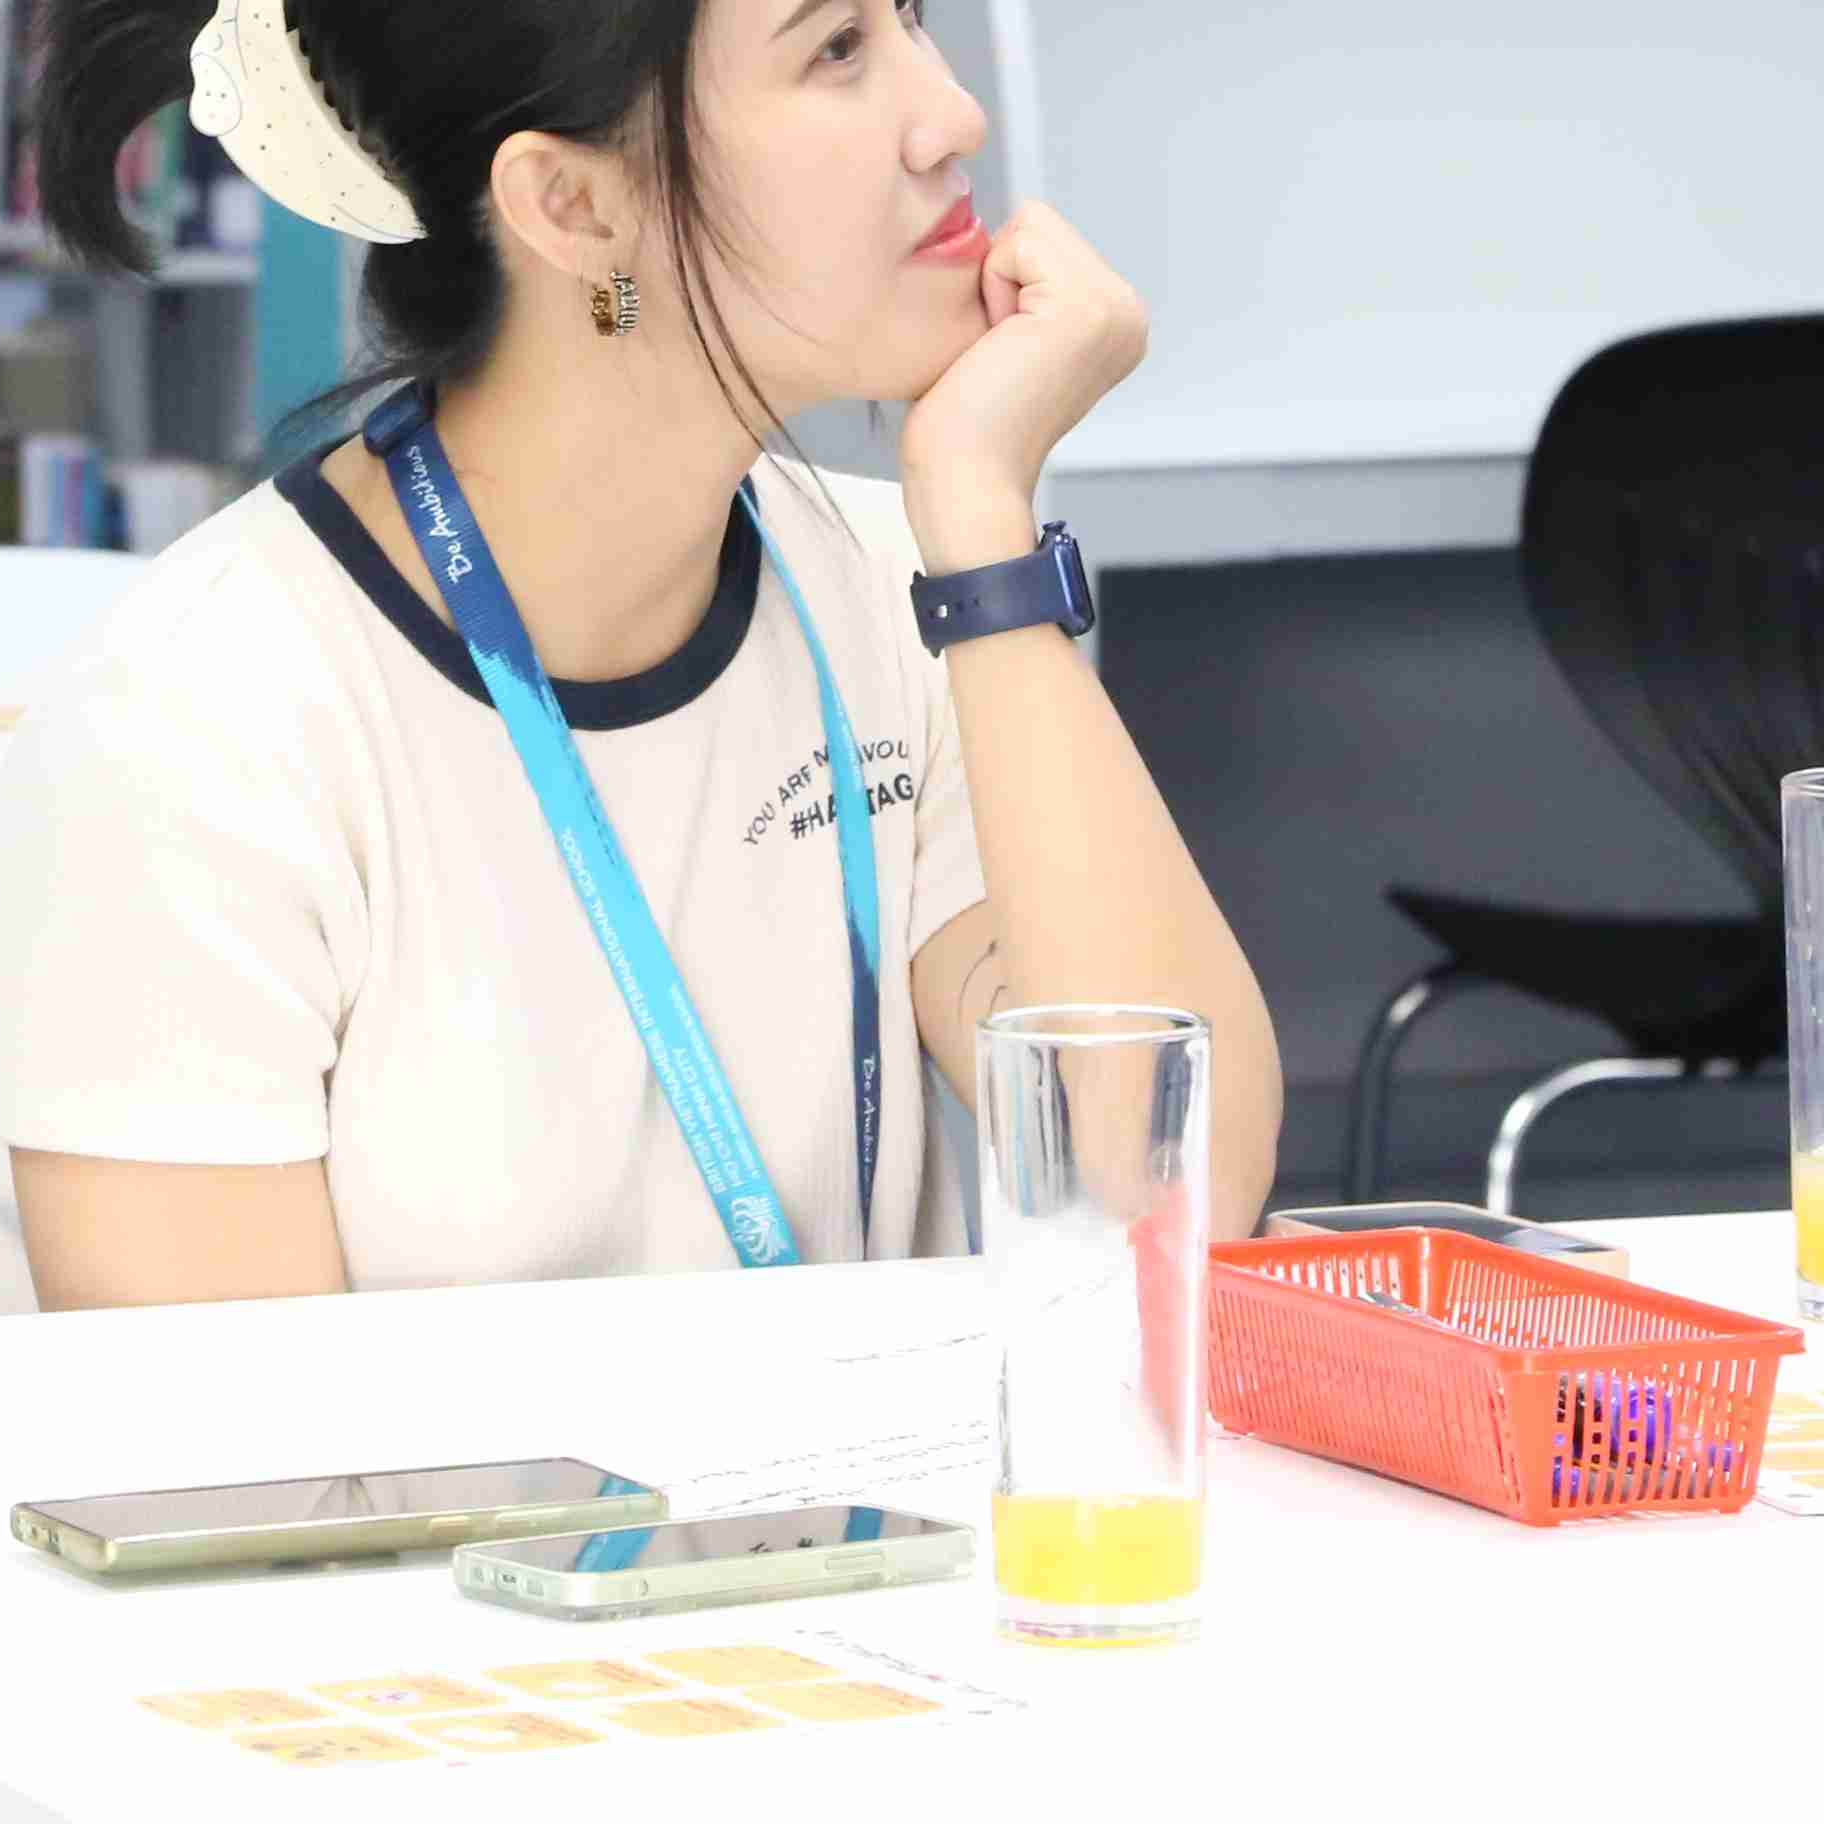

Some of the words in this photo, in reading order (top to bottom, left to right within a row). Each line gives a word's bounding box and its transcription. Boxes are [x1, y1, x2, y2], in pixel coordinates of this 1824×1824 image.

[407, 445, 459, 537] Ambitious
[447, 542, 473, 584] Be
[744, 802, 776, 845] YOU
[790, 773, 914, 839] #HATAG
